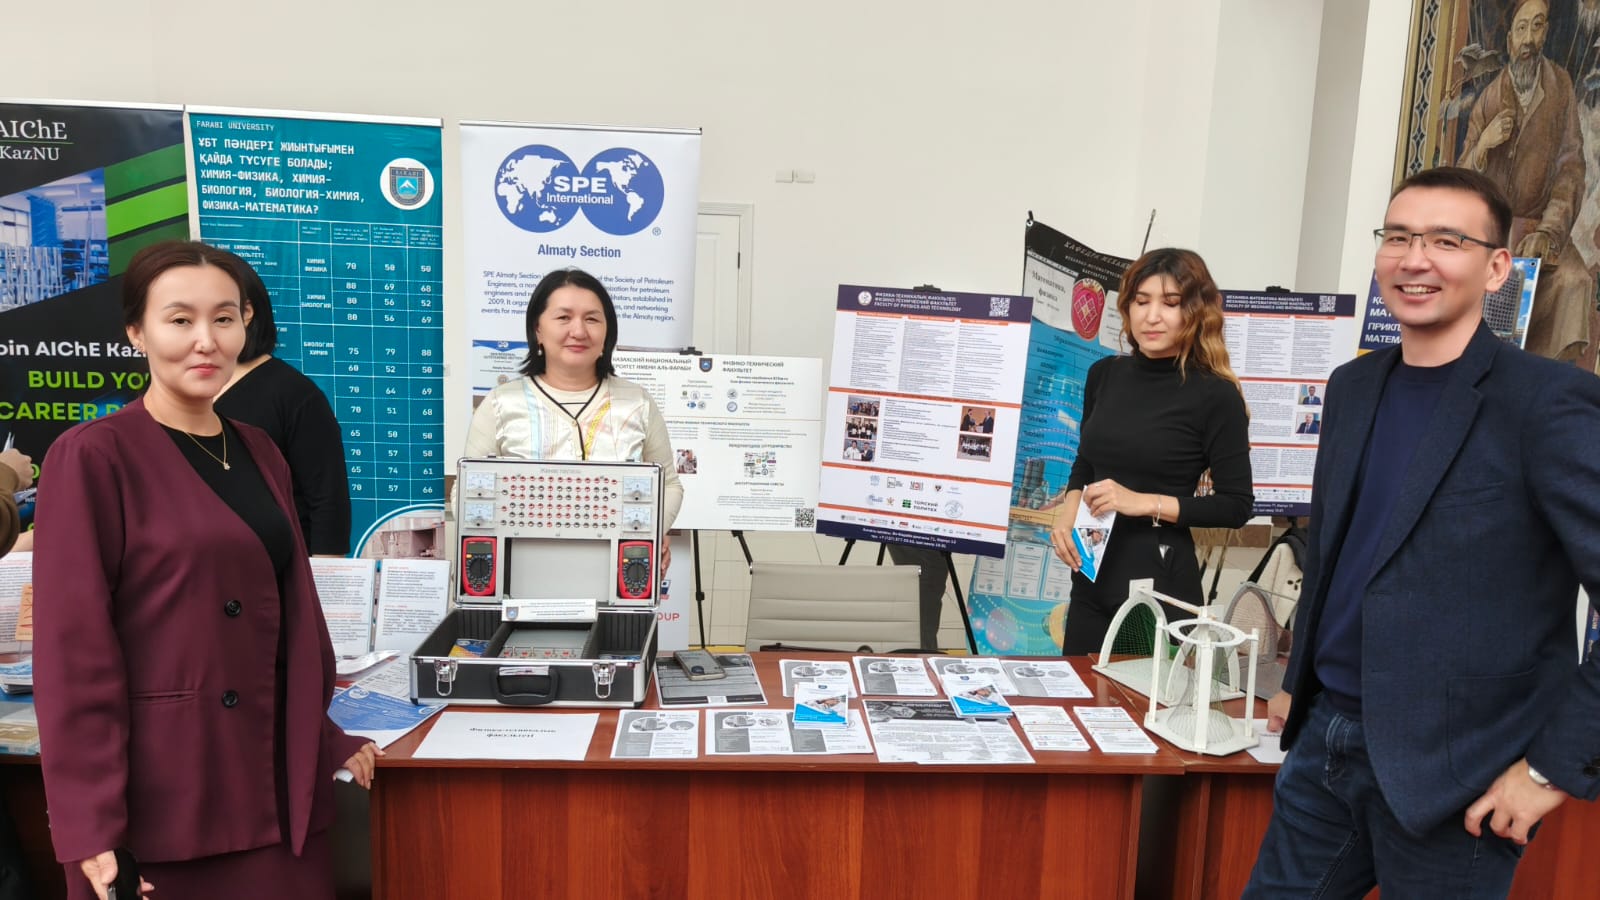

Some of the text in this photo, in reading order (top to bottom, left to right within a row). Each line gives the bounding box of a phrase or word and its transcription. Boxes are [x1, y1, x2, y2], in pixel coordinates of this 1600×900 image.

[196, 120, 275, 132] FARABI UNIVERSITY
[0, 146, 60, 161] KazNU
[198, 137, 355, 155] ҰБТ ПӘНДЕРІ ЖИЫНТЫҒЫМЕН
[199, 152, 233, 166] ҚАЙДА
[239, 155, 281, 166] ТҮСУГЕ
[200, 169, 332, 184] ХИМИЯ-ФИЗИКА, ХИМИЯ-
[553, 175, 608, 193] SPE
[201, 185, 365, 203] БИОЛОГИЯ, БИОЛОГИЯ-ХИМИЯ,
[546, 192, 614, 205] International
[202, 200, 319, 215] ФИЗИКА-МАТЕМАТИКА?
[537, 244, 621, 258] Almaty Section
[35, 341, 101, 357] AIChE
[28, 370, 105, 389] BUILD
[0, 402, 97, 421] CAREER
